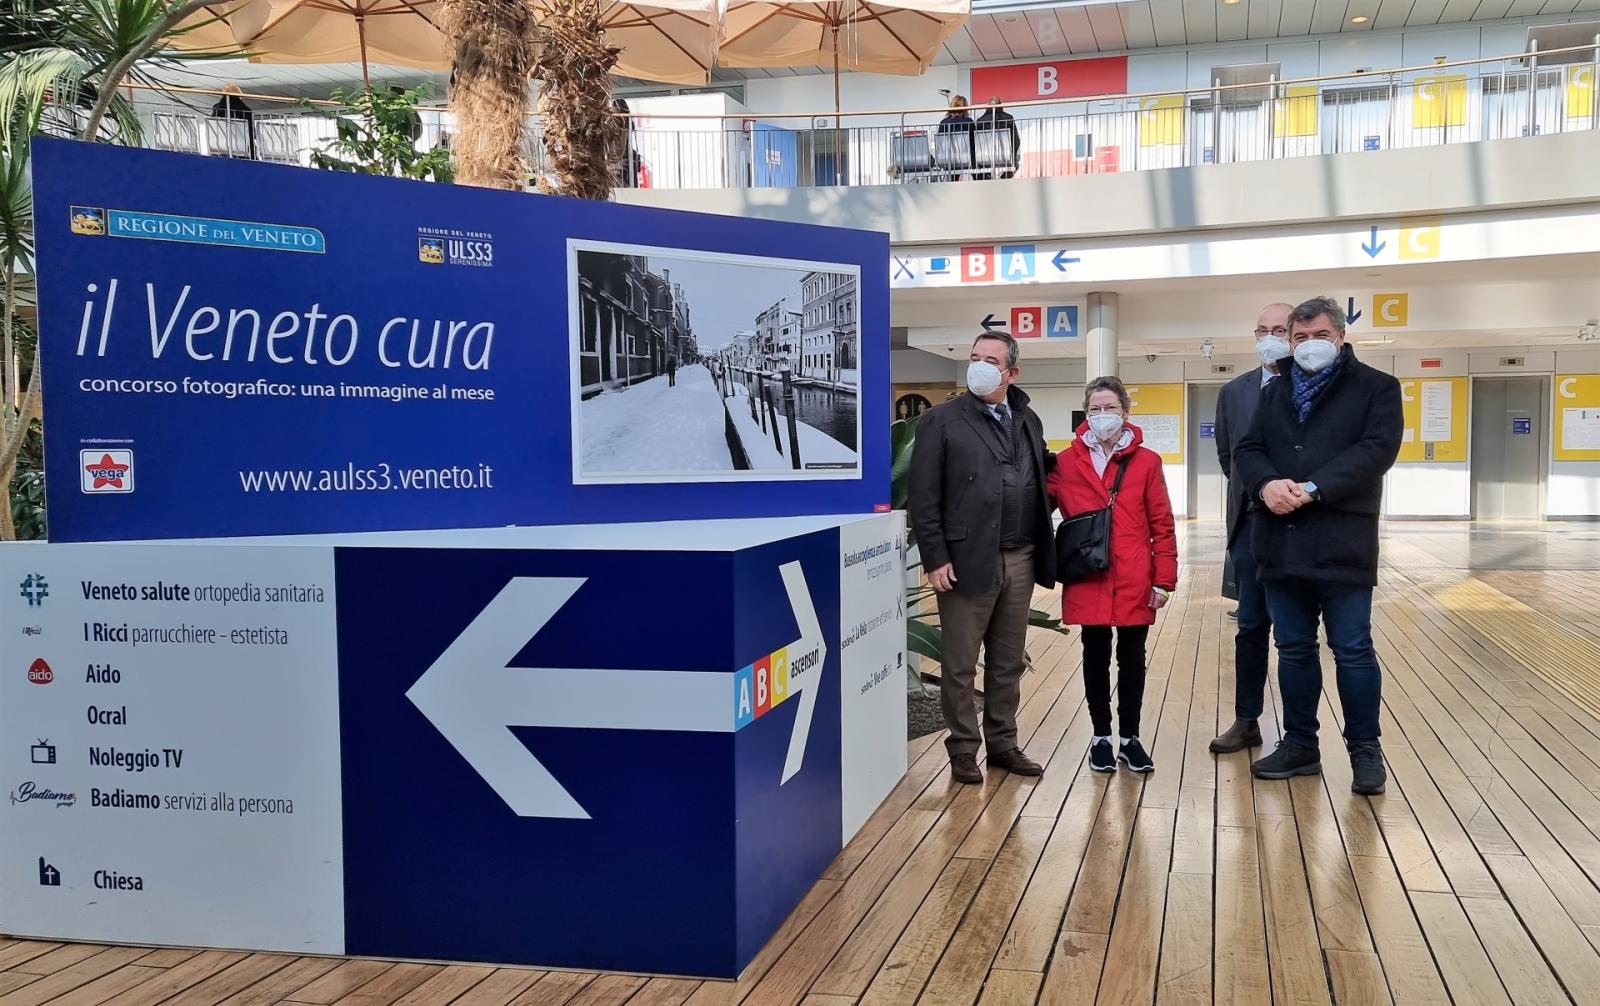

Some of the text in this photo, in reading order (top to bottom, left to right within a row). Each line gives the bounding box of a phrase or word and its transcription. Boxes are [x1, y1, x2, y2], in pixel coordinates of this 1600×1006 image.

[1037, 66, 1059, 96] B
[1417, 79, 1436, 100] C
[118, 217, 316, 247] REGIONE DEL VENETO
[418, 227, 449, 235] REGIONE
[1408, 227, 1431, 252] C
[449, 240, 493, 262] ULSS3
[450, 258, 493, 267] SERENISSIMA
[968, 252, 1029, 276] B A
[1380, 299, 1399, 321] C
[76, 278, 495, 370] il Veneto cura
[1017, 312, 1072, 333] B A
[80, 376, 495, 401] concorso fotografico: una immagine al mese
[1560, 378, 1577, 398] C
[91, 469, 124, 480] vega
[240, 462, 494, 492] www.aulss3.veneto.it
[81, 581, 324, 606] Veneto salute ortopedia sanitaria
[84, 622, 89, 641] I
[93, 623, 128, 642] Ricci
[132, 624, 216, 647] parrucchiere
[230, 626, 288, 645] estetista
[29, 669, 52, 680] aido
[86, 664, 121, 684] Aido
[738, 642, 819, 719] A B C ascensori
[87, 705, 127, 725] Ocral
[89, 747, 183, 772] Noleggio TV
[18, 781, 76, 802] Badiamo
[91, 788, 293, 816] Badiamo servizi alla persona
[94, 870, 143, 891] Chiesa
